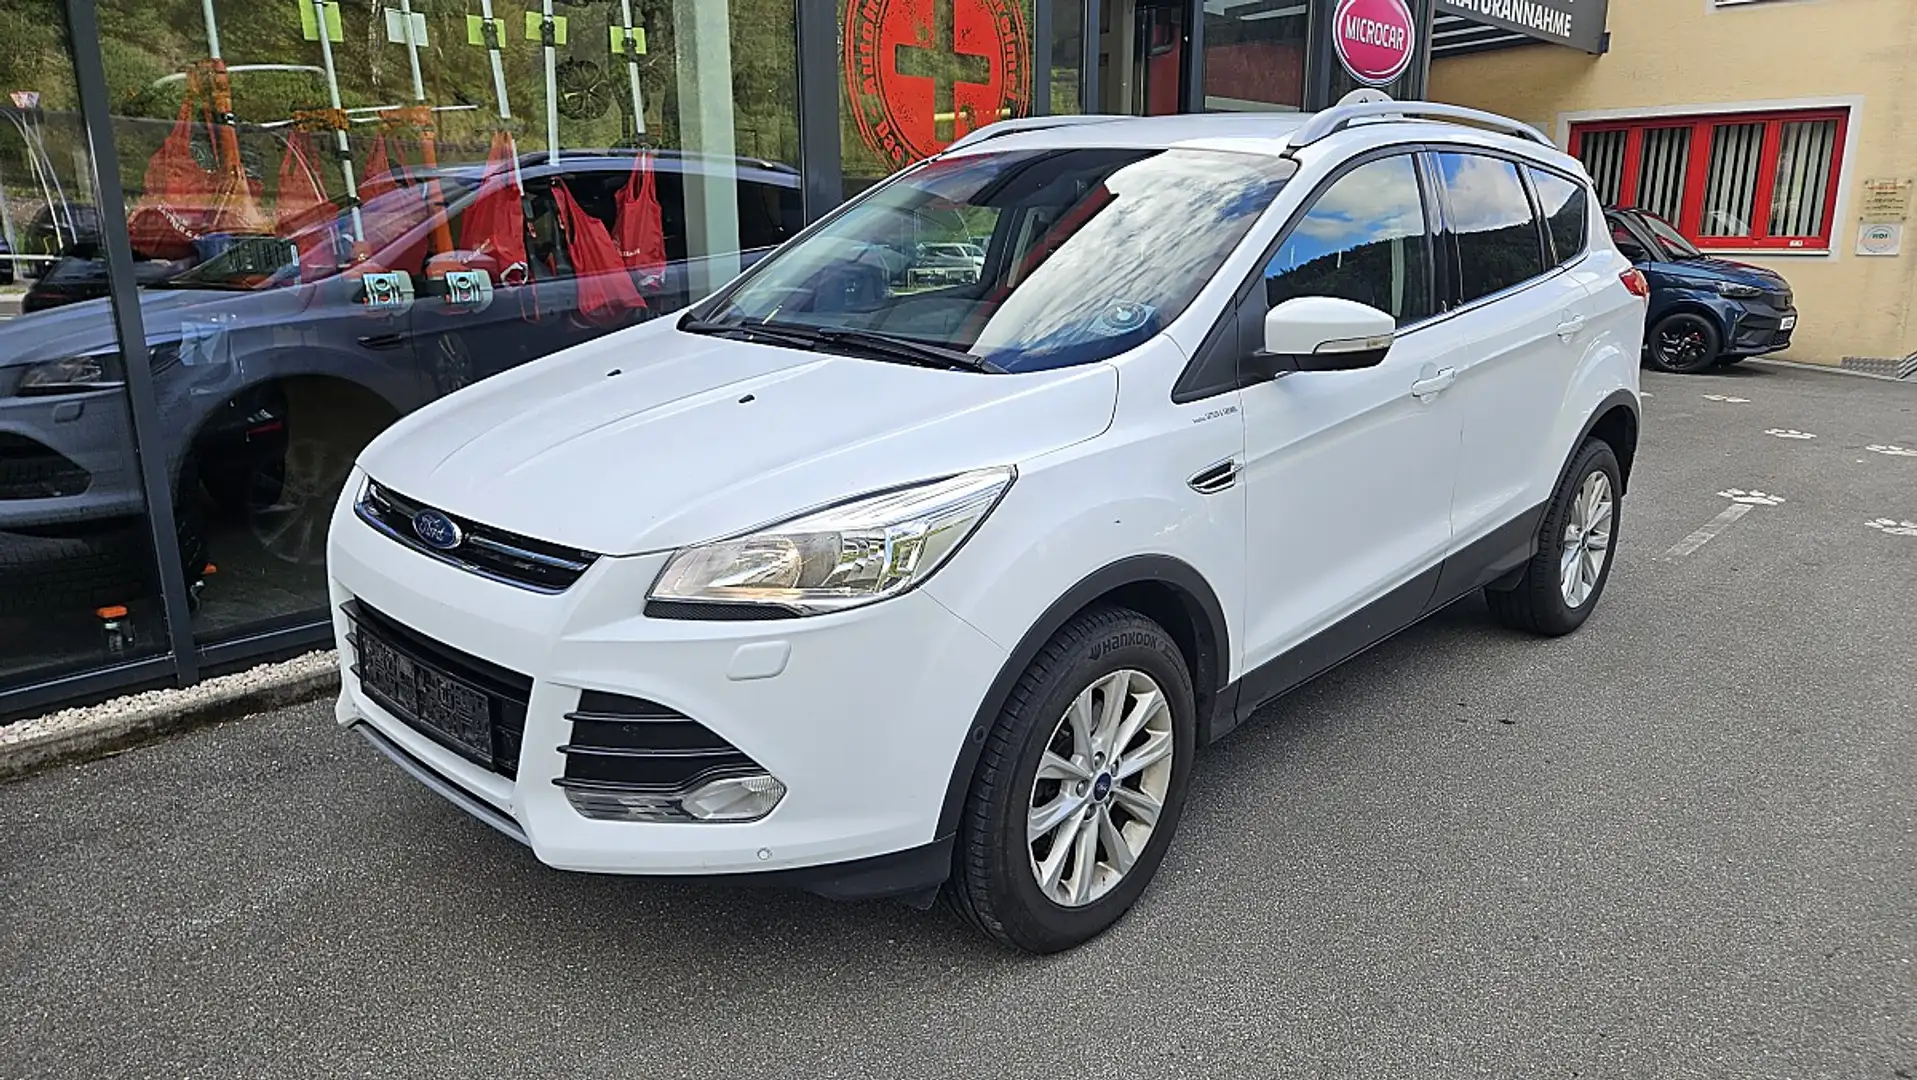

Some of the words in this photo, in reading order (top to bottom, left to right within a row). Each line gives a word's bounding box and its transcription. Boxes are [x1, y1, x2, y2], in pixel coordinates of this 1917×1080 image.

[1345, 14, 1405, 51] MICROCAR
[1446, 0, 1572, 38] URANNAHME
[875, 120, 903, 161] Das
